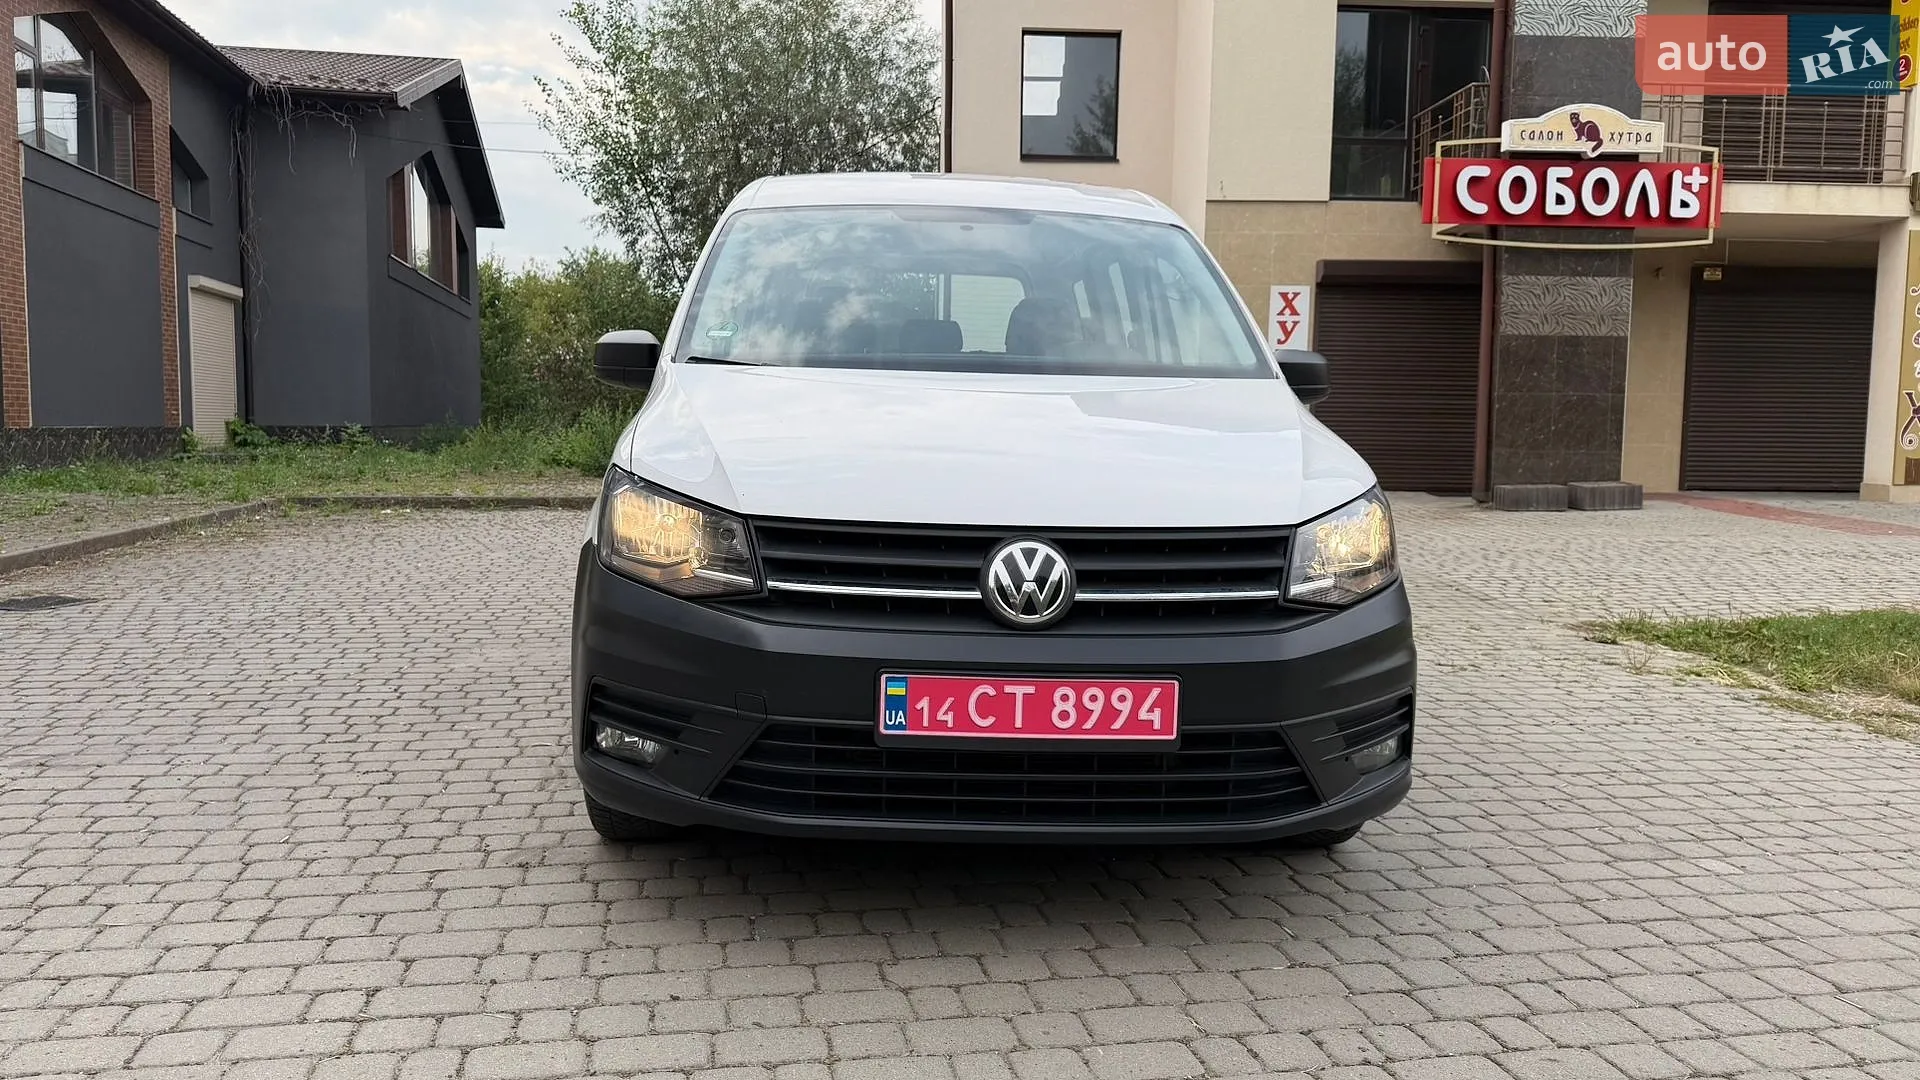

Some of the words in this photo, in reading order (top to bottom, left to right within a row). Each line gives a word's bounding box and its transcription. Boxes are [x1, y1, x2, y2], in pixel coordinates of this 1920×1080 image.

[885, 710, 906, 726] UA
[914, 696, 955, 729] 14
[967, 684, 1036, 729] CT
[1050, 685, 1162, 731] 8994
